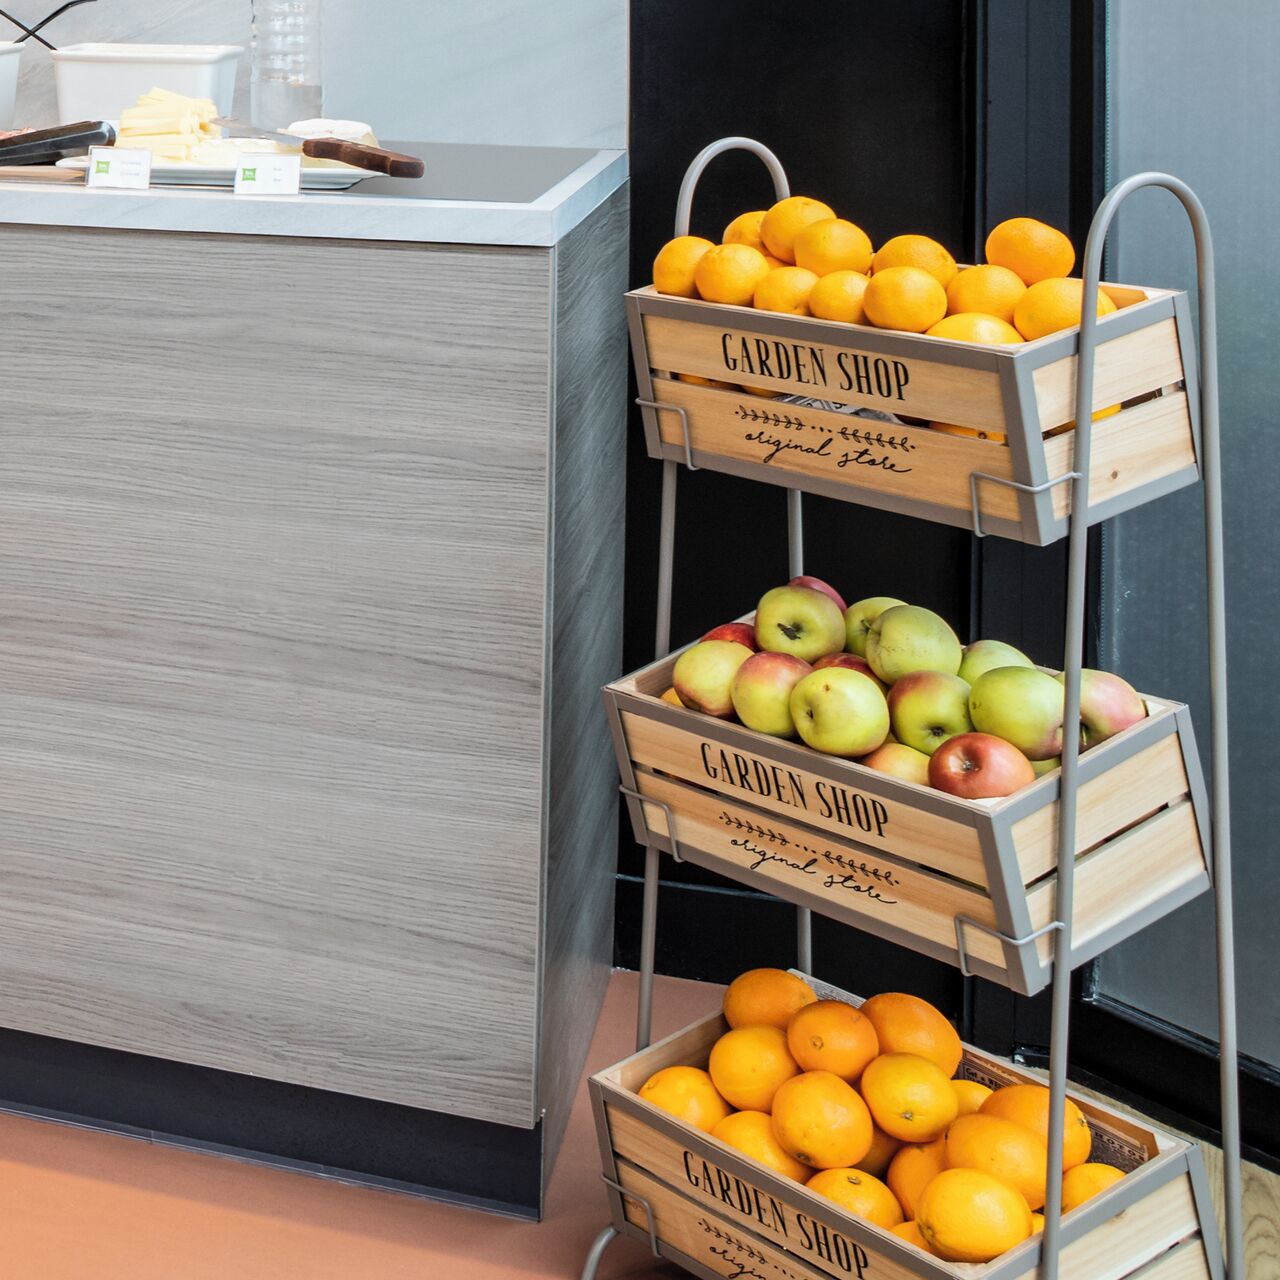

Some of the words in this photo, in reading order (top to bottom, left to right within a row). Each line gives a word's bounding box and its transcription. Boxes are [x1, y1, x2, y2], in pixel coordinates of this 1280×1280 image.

[721, 333, 828, 387] GARDEN
[837, 352, 910, 401] SHOP
[745, 431, 833, 464] original
[837, 448, 913, 473] store
[700, 742, 808, 810] GARDEN
[815, 781, 889, 838] SHOP
[730, 838, 818, 875] original
[823, 873, 898, 905] store
[683, 1150, 789, 1239] GARDEN
[796, 1213, 869, 1280] SHOP
[709, 1246, 770, 1280] origin
